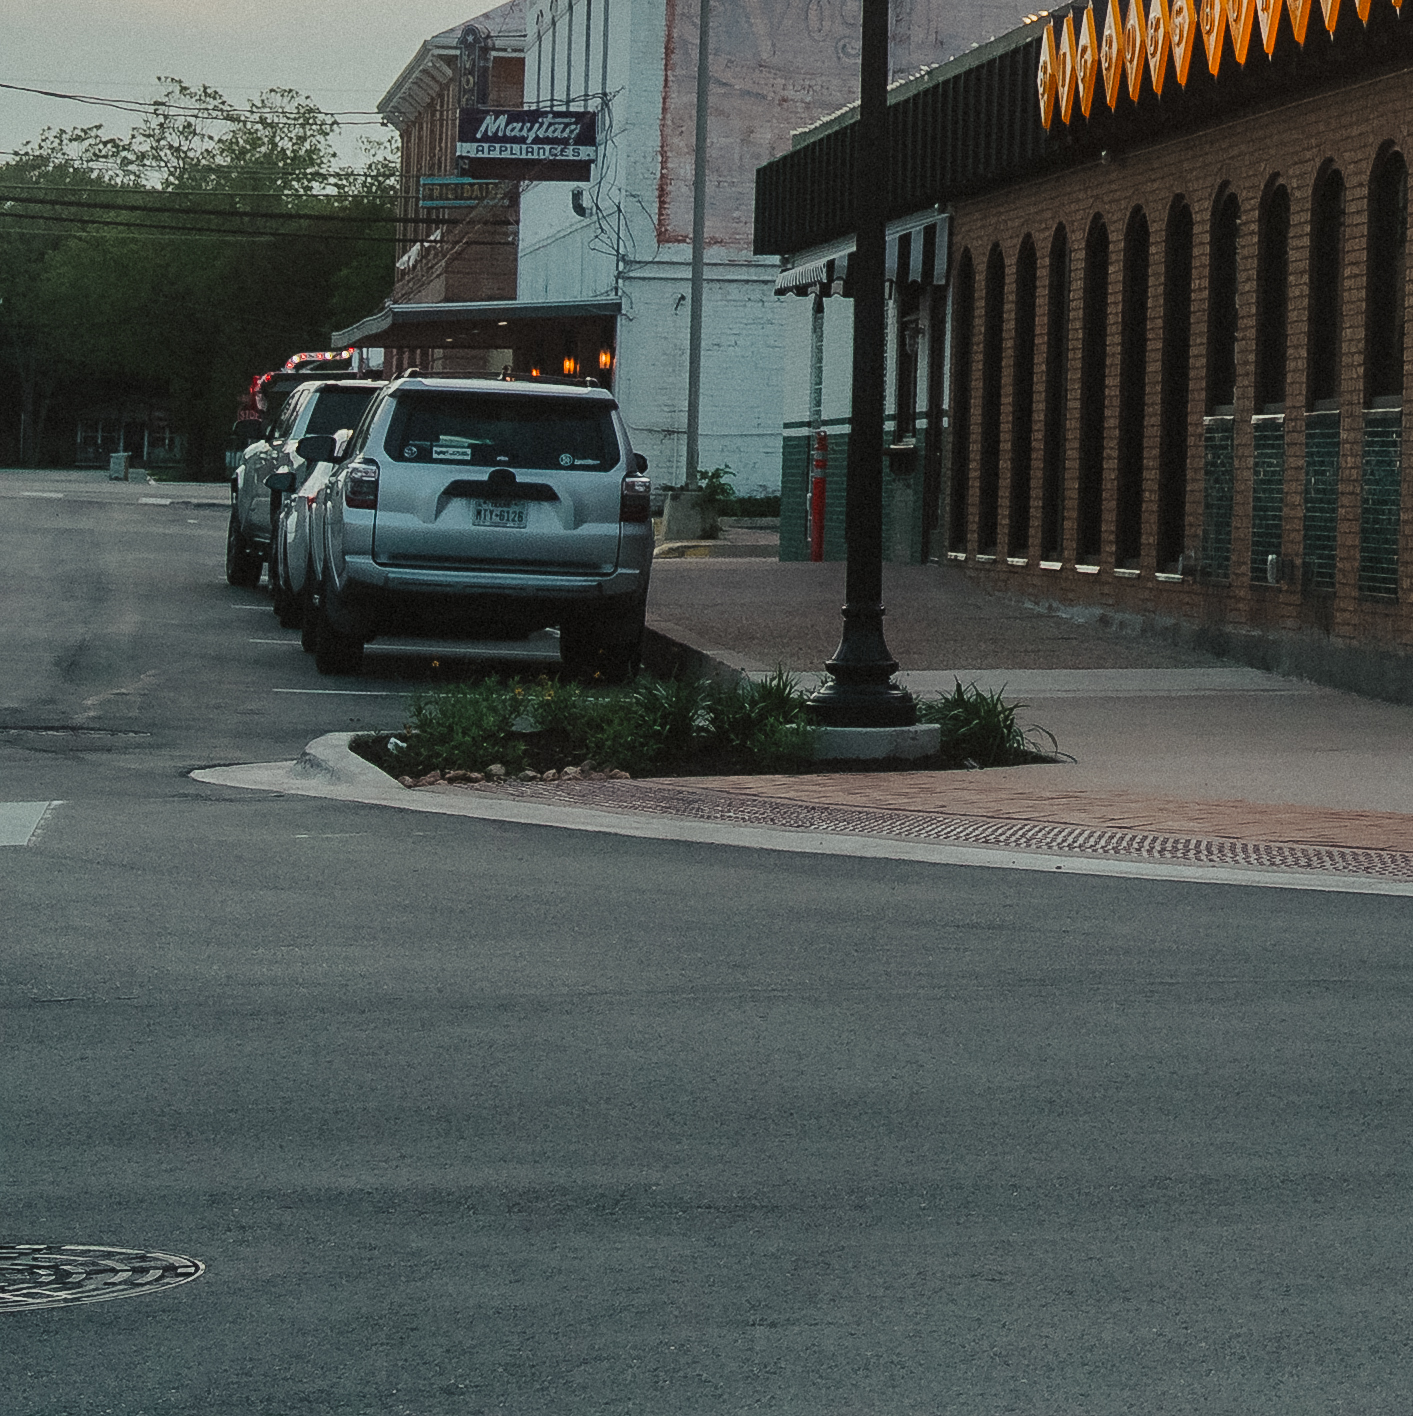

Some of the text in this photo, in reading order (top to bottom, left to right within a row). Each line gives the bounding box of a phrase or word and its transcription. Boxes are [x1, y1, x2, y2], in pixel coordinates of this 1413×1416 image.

[1040, 44, 1088, 100] BIG
[476, 113, 582, 145] Maytag
[475, 144, 581, 158] APPLIANCES
